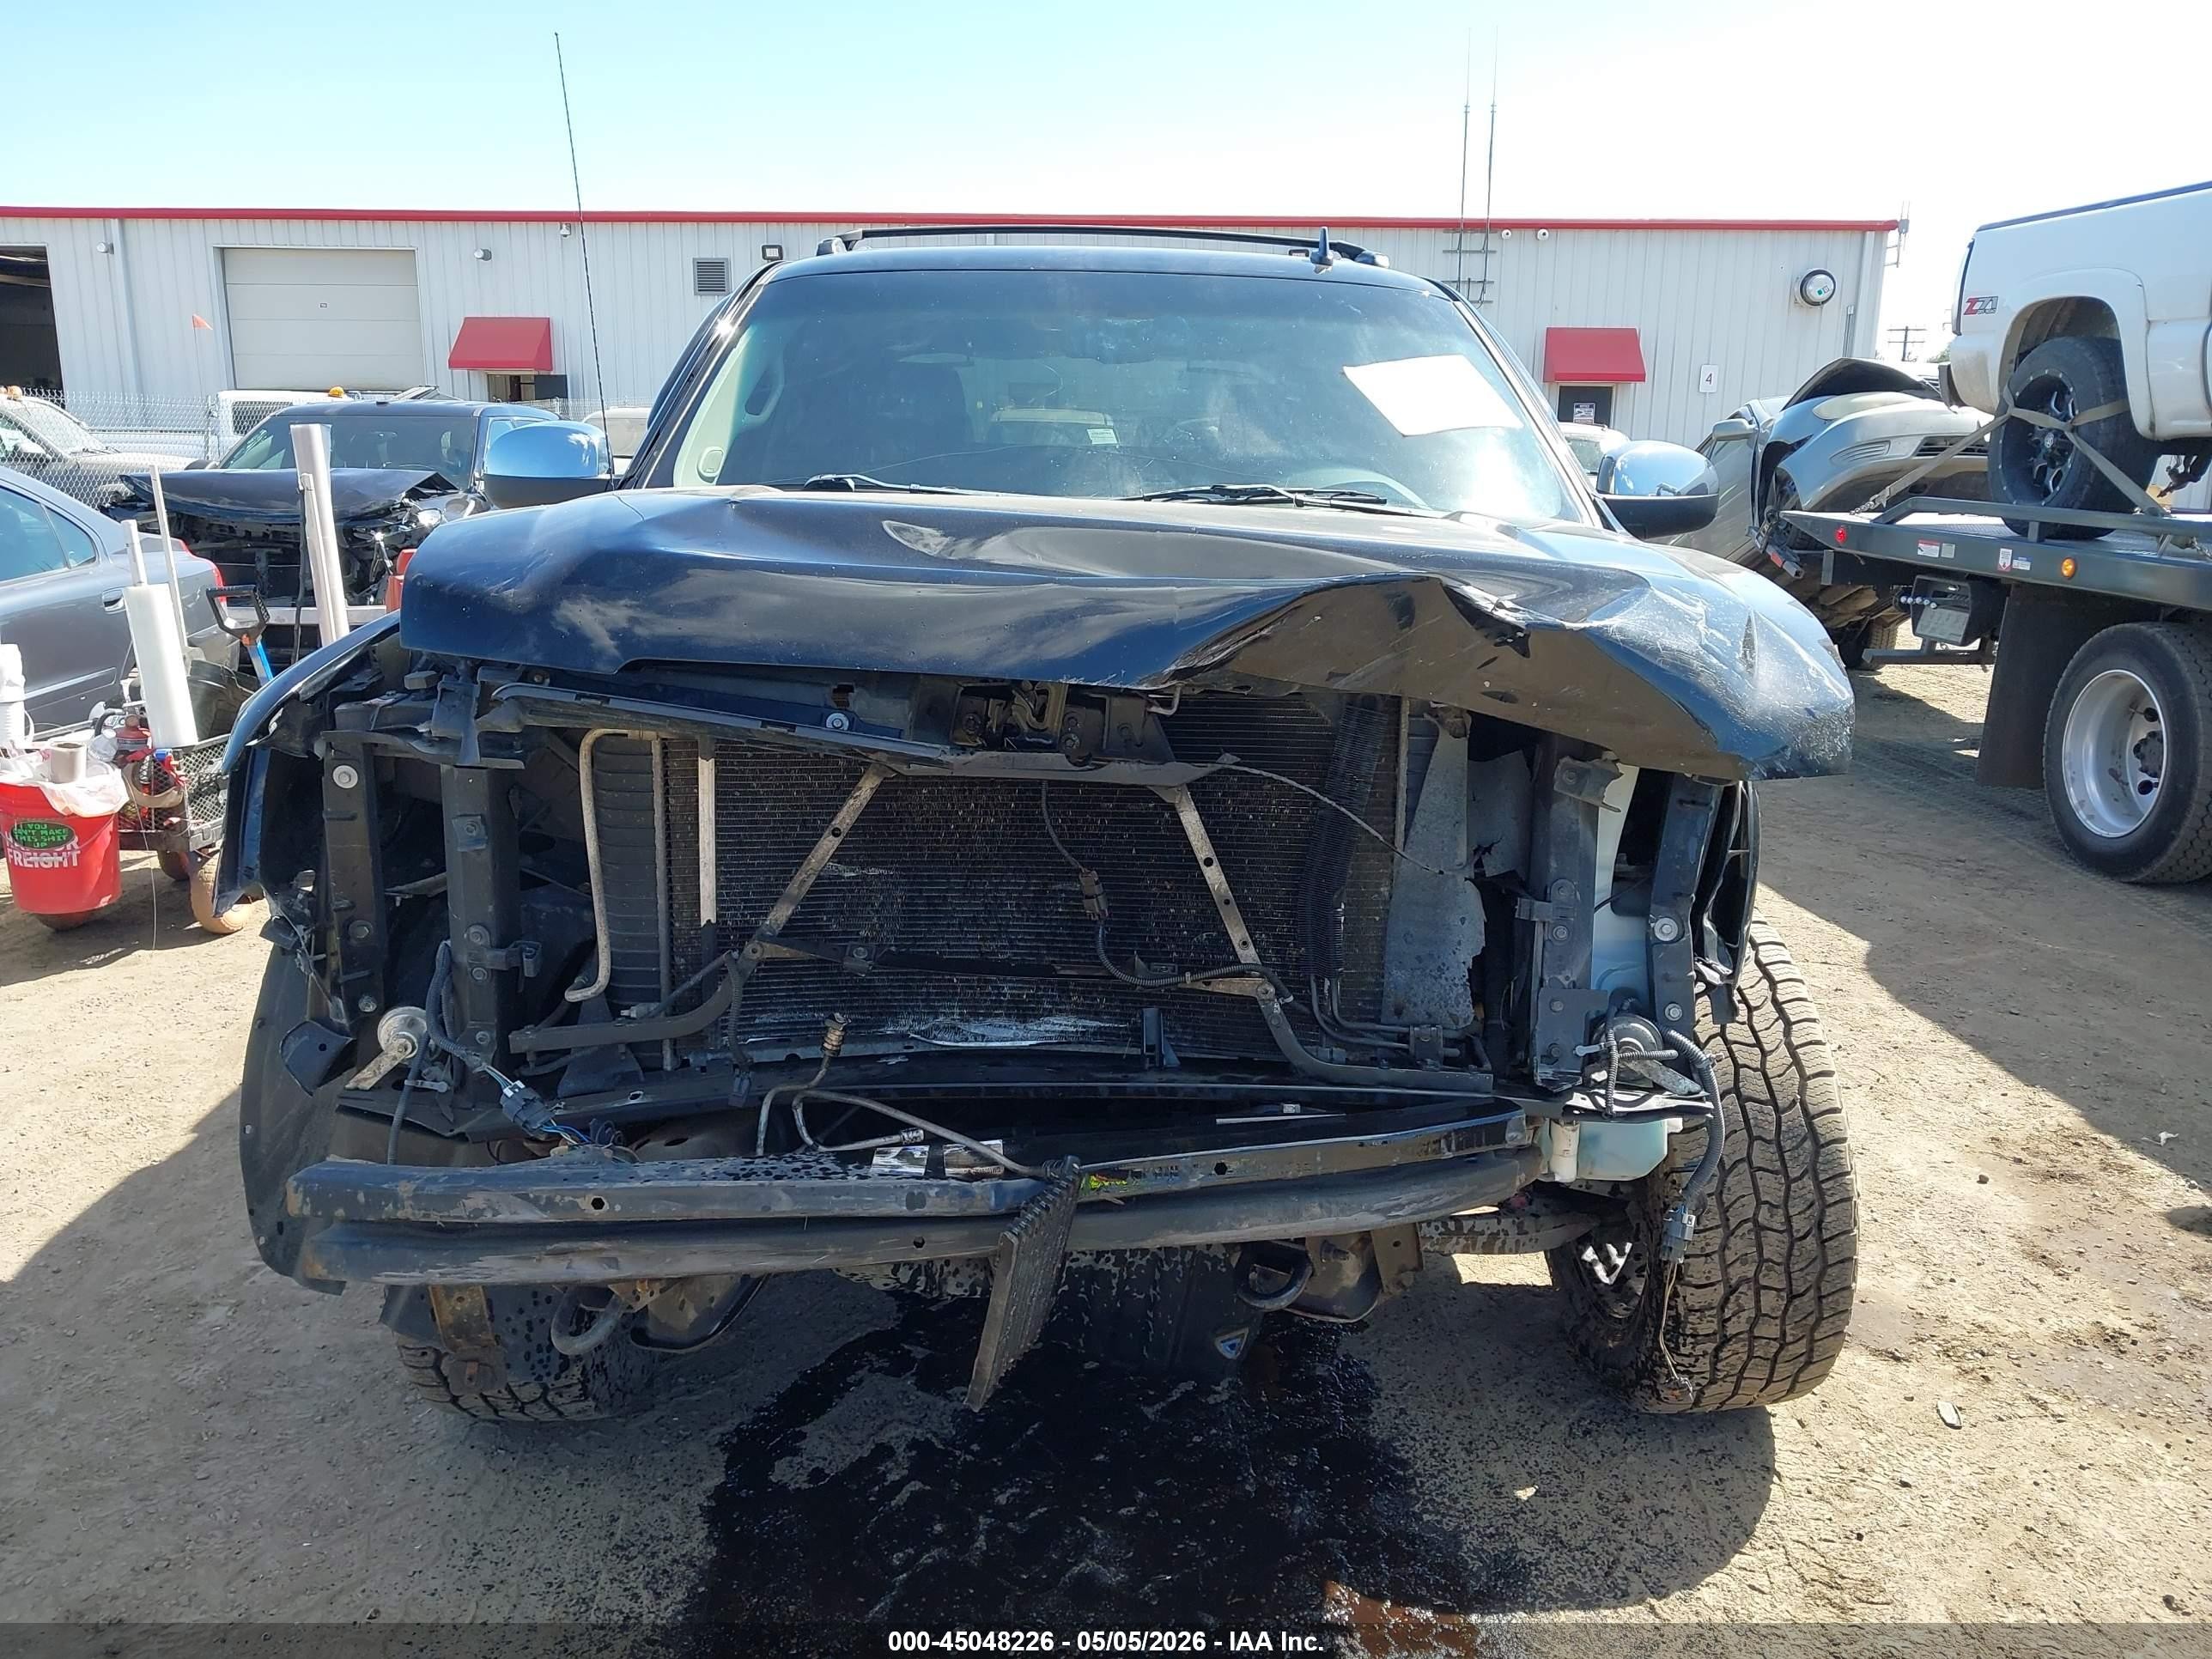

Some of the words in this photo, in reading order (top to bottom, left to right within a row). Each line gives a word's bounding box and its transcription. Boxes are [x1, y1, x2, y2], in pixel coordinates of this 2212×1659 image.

[1964, 296, 1998, 315] Z71
[1705, 373, 1712, 385] 4
[7, 848, 81, 868] FREIGHT
